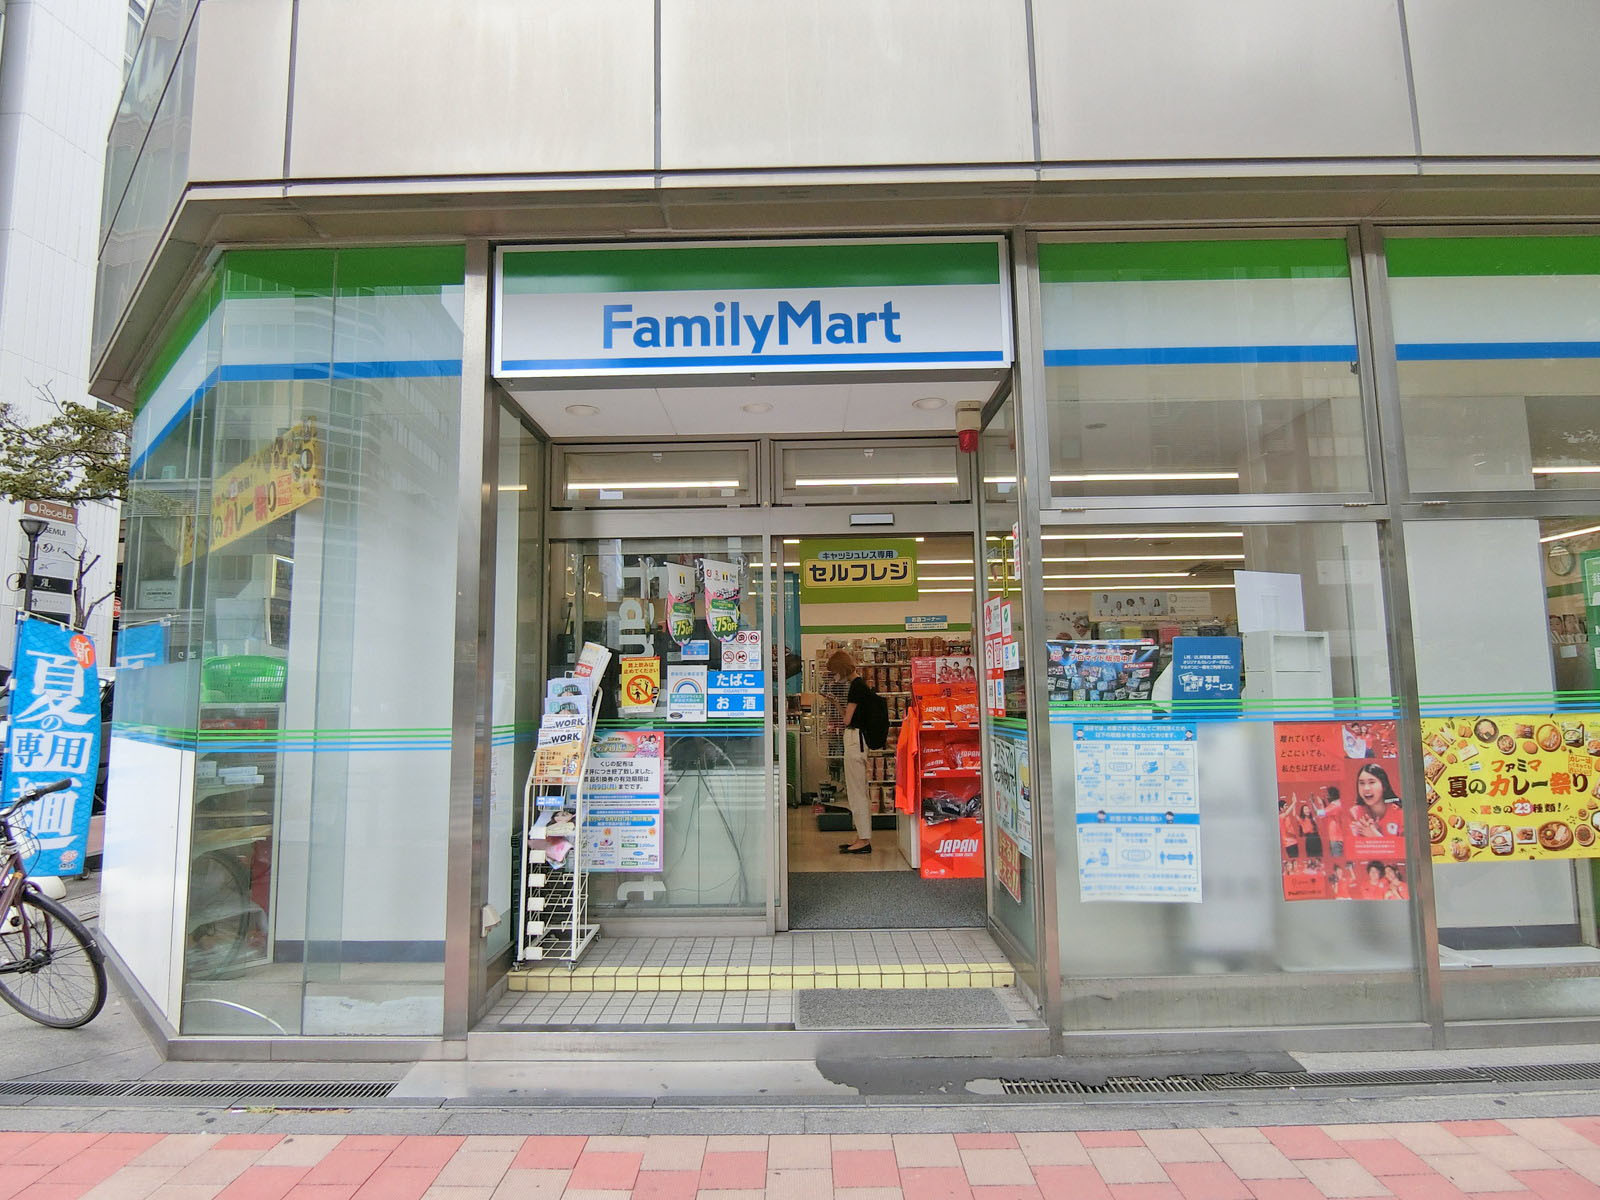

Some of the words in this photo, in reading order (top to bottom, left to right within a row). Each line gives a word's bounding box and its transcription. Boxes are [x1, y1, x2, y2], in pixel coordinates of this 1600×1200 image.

[602, 300, 901, 354] FamilyMart
[822, 550, 894, 560] キャッシュレス専用
[809, 561, 908, 582] セルフレジ
[73, 638, 91, 665] 新
[716, 673, 755, 687] たばこ
[1204, 675, 1220, 683] 写真
[1204, 683, 1234, 691] サービス
[555, 717, 585, 729] WORK
[551, 732, 581, 744] WORK
[14, 732, 88, 769] 専用
[1491, 758, 1542, 773] ファミマ
[1447, 772, 1589, 798] 夏のカレー祭り
[1480, 802, 1562, 815] 驚きの23種類!
[935, 839, 979, 853] JAPAN
